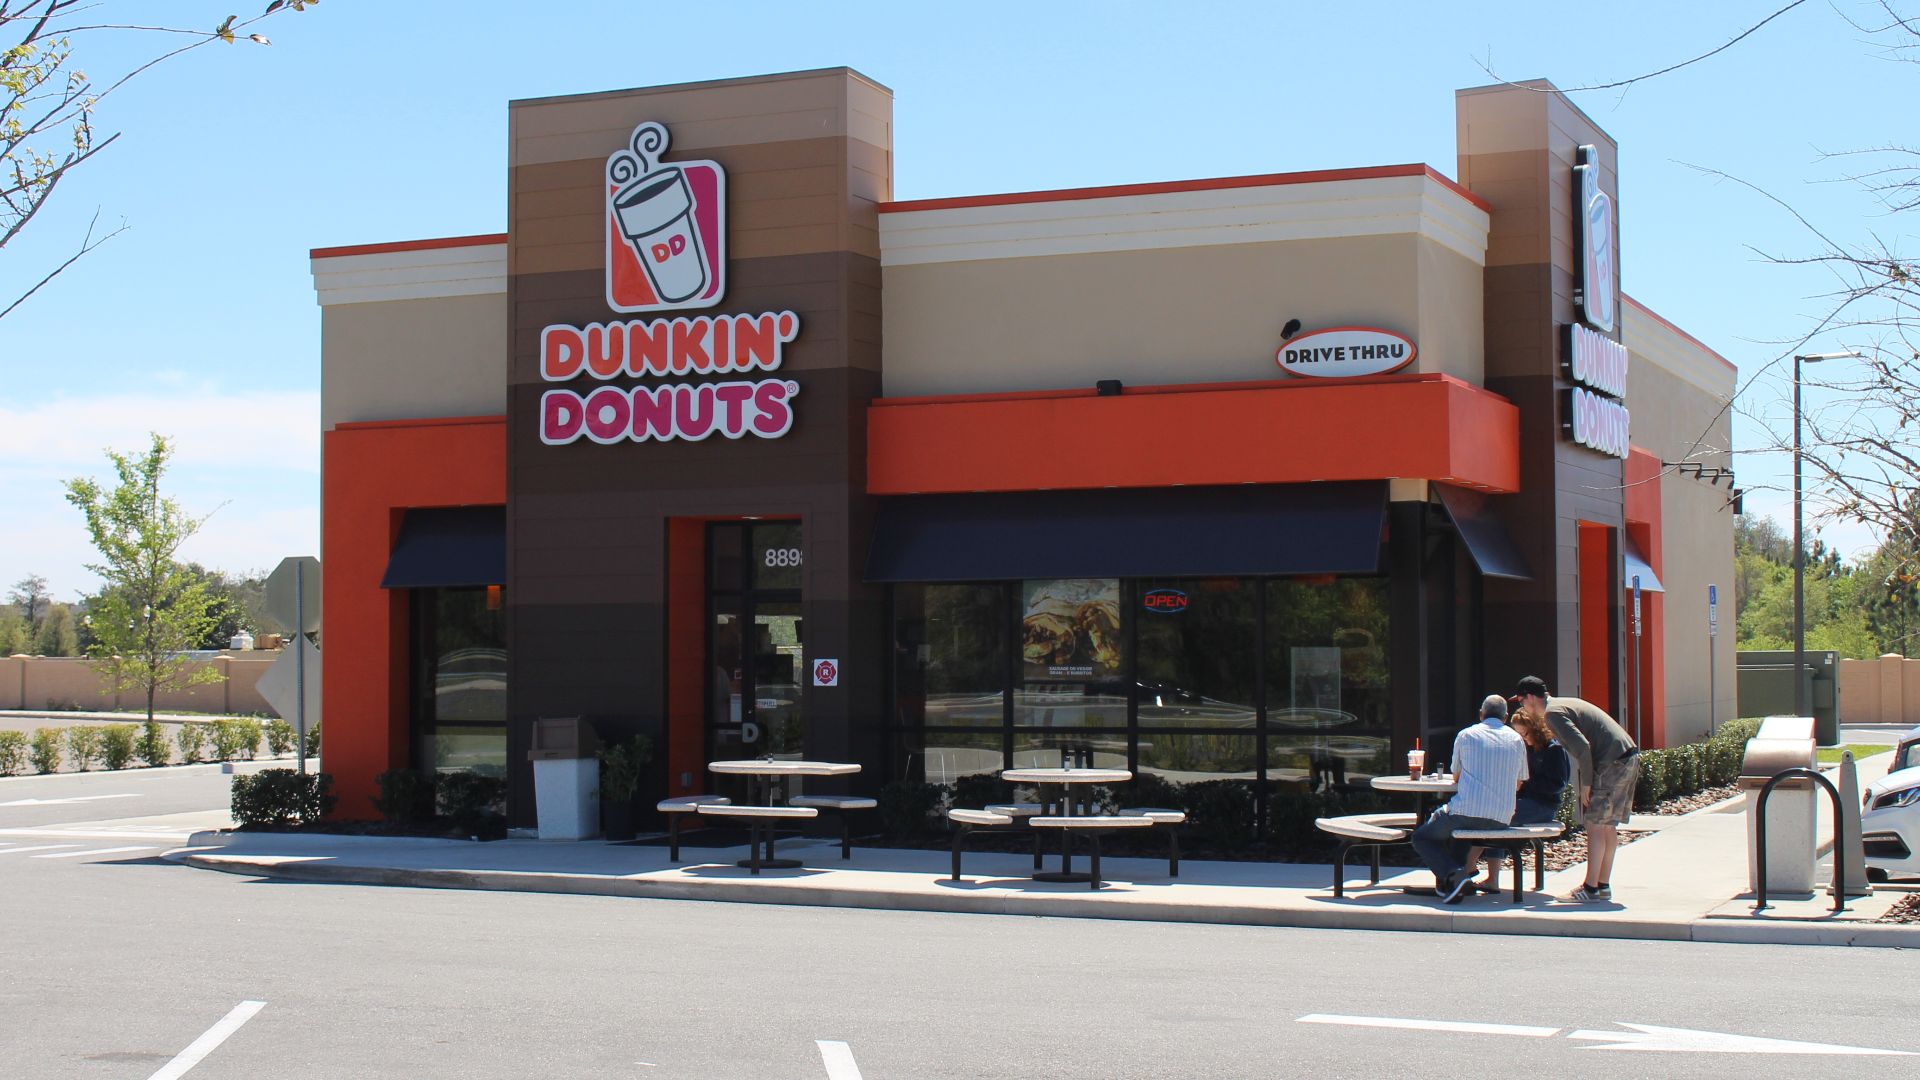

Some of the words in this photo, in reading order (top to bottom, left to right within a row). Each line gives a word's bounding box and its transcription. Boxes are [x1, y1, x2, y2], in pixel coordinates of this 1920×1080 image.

[651, 234, 686, 263] DD
[543, 312, 796, 379] DUNKIN'
[1285, 346, 1346, 364] DRIVE
[1349, 343, 1404, 361] THRU
[765, 548, 803, 567] 889
[1144, 595, 1188, 608] OPEN
[742, 722, 759, 743] D
